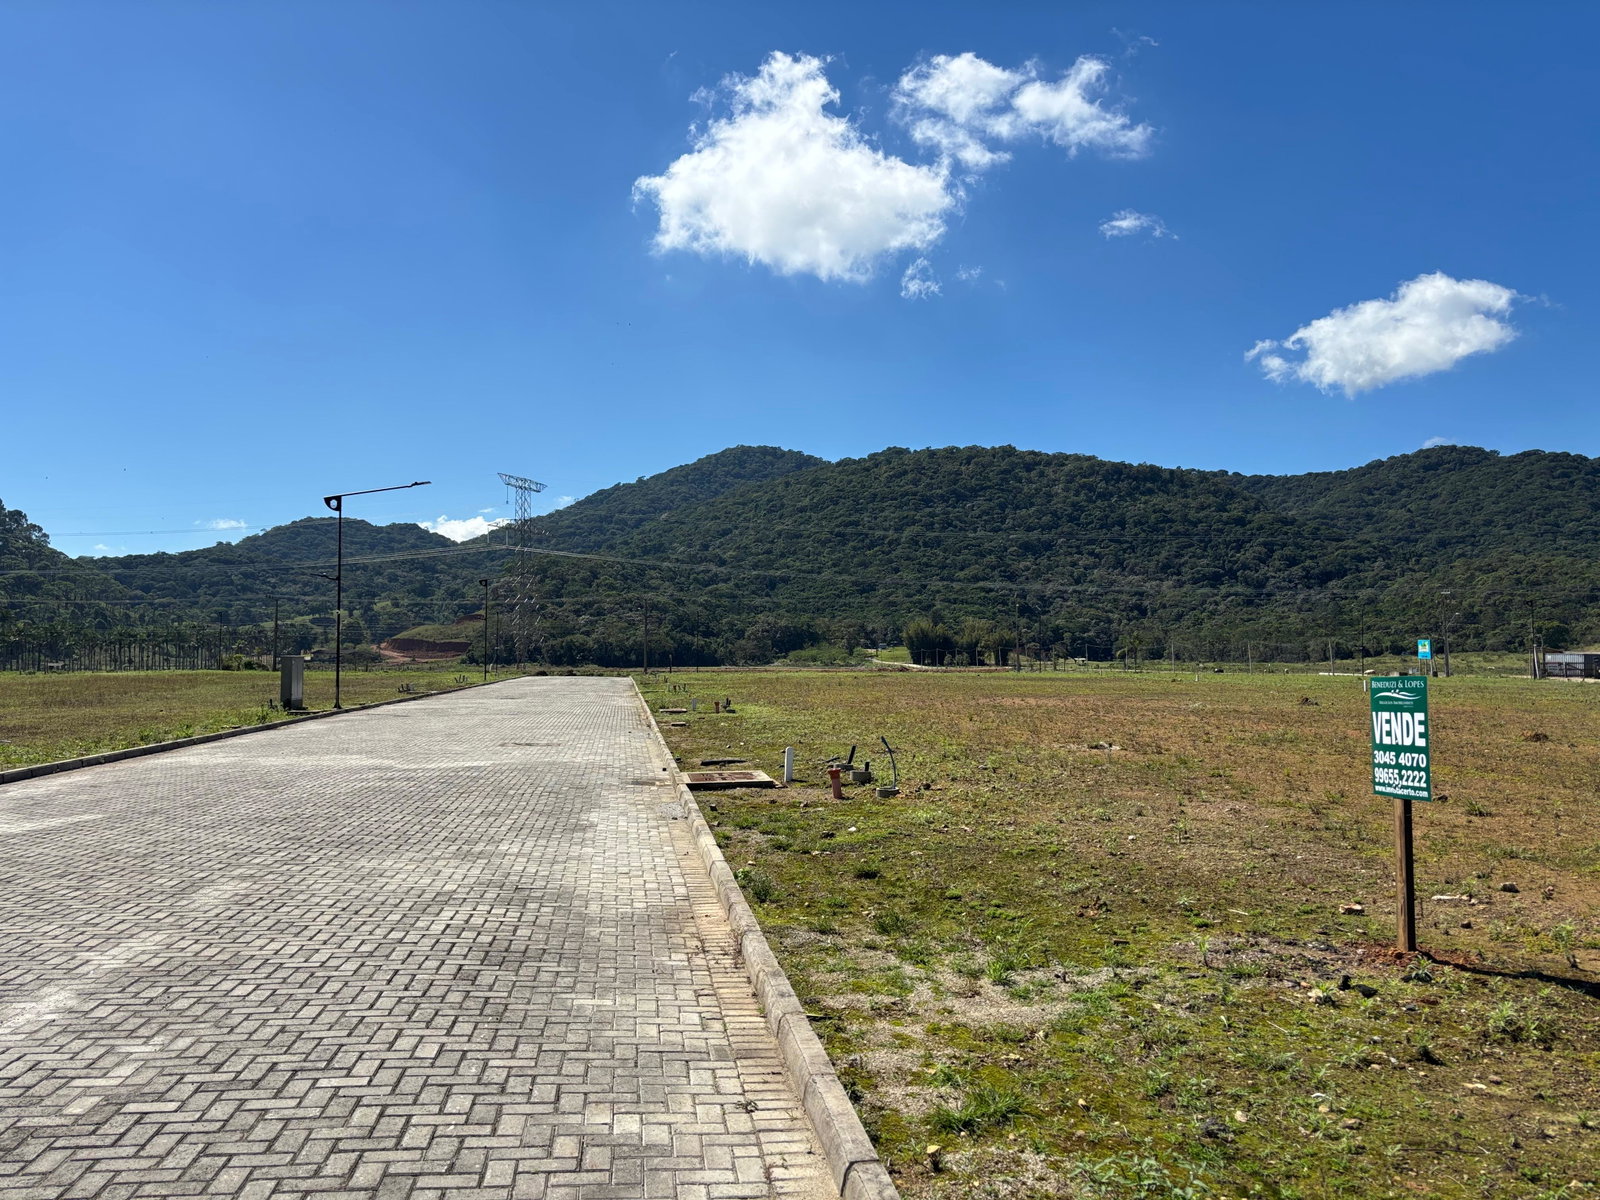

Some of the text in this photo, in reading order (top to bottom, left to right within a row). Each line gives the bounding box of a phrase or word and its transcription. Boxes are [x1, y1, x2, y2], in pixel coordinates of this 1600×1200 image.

[1397, 679, 1403, 688] &
[1404, 679, 1425, 688] LOPES
[1372, 711, 1426, 747] VENDE
[1373, 750, 1427, 768] 3045 4070
